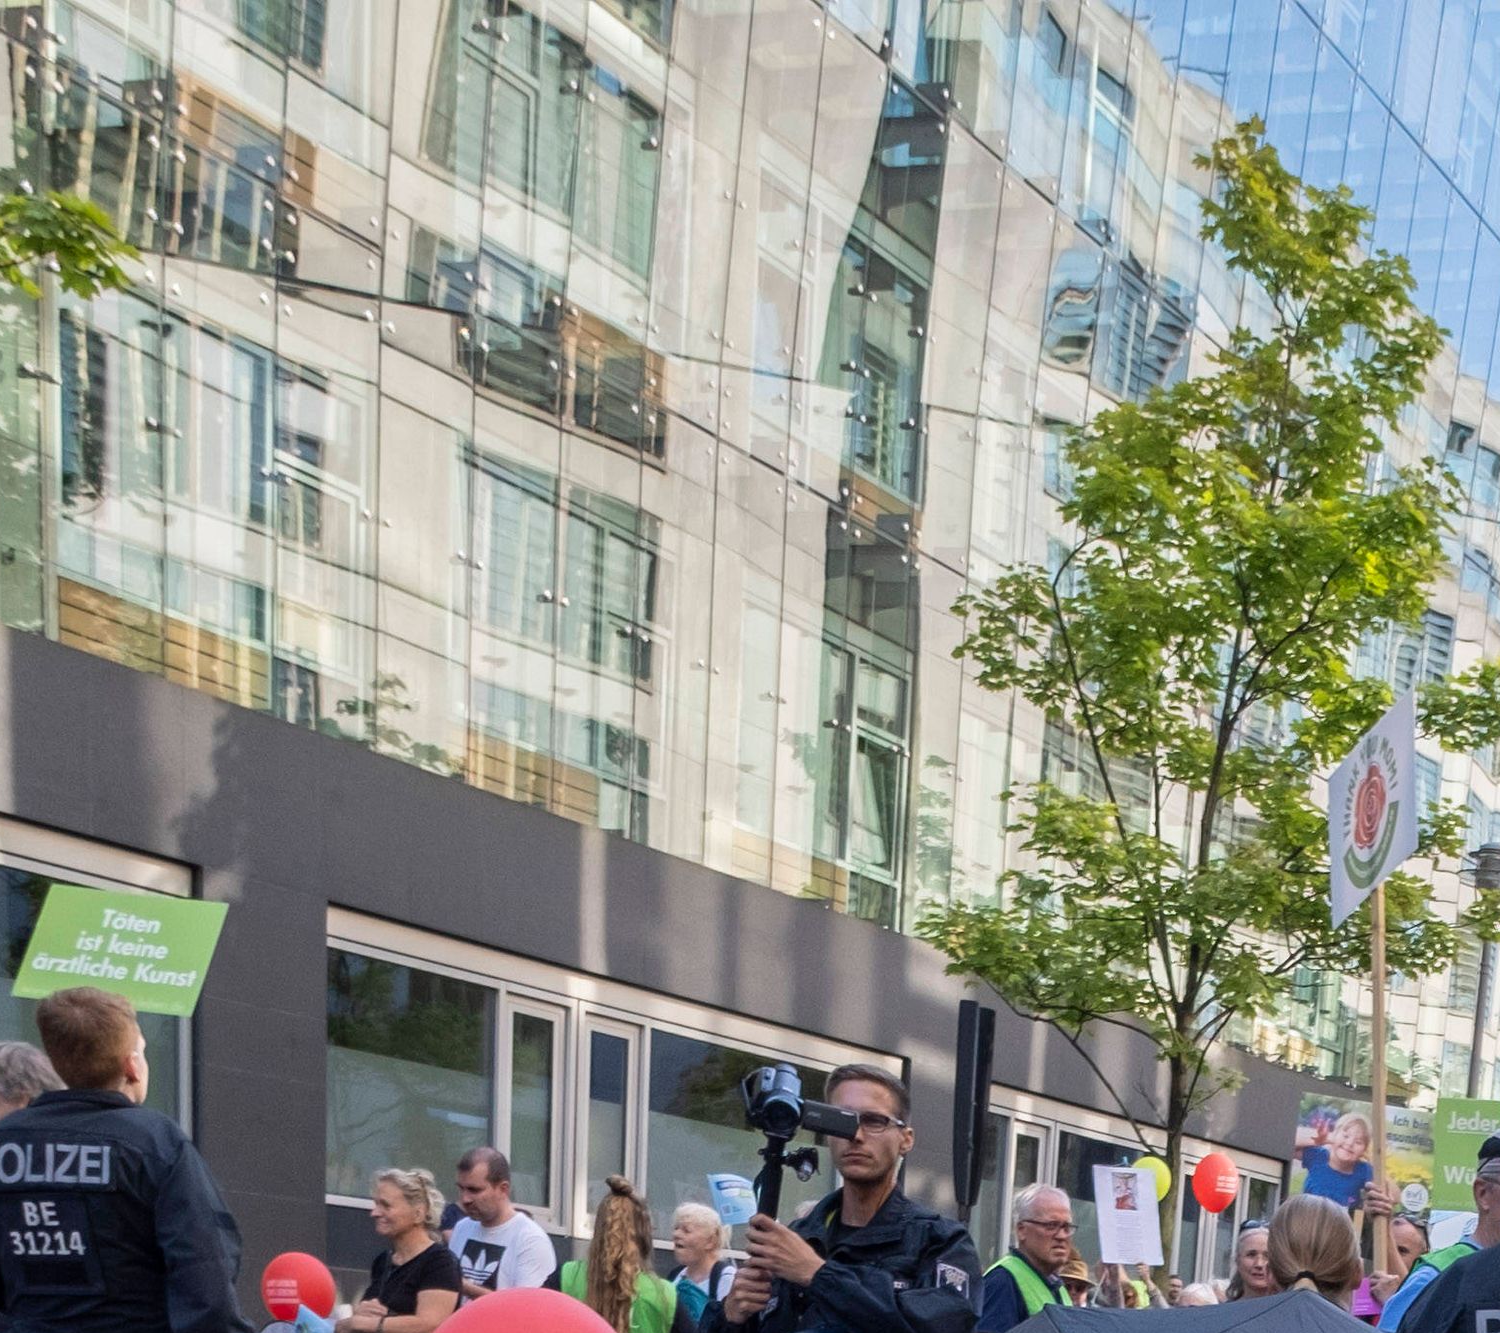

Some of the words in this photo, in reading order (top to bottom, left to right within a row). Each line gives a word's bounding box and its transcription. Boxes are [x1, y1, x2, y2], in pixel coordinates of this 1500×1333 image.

[102, 908, 162, 935] Töten
[76, 930, 104, 952] ist
[108, 933, 169, 960] keine
[32, 952, 129, 981] ärztliche
[133, 962, 198, 988] Kunst
[1393, 1115, 1409, 1127] Ich
[1447, 1110, 1500, 1133] Jeder
[23, 1202, 60, 1227] BE
[10, 1231, 86, 1256] 31214
